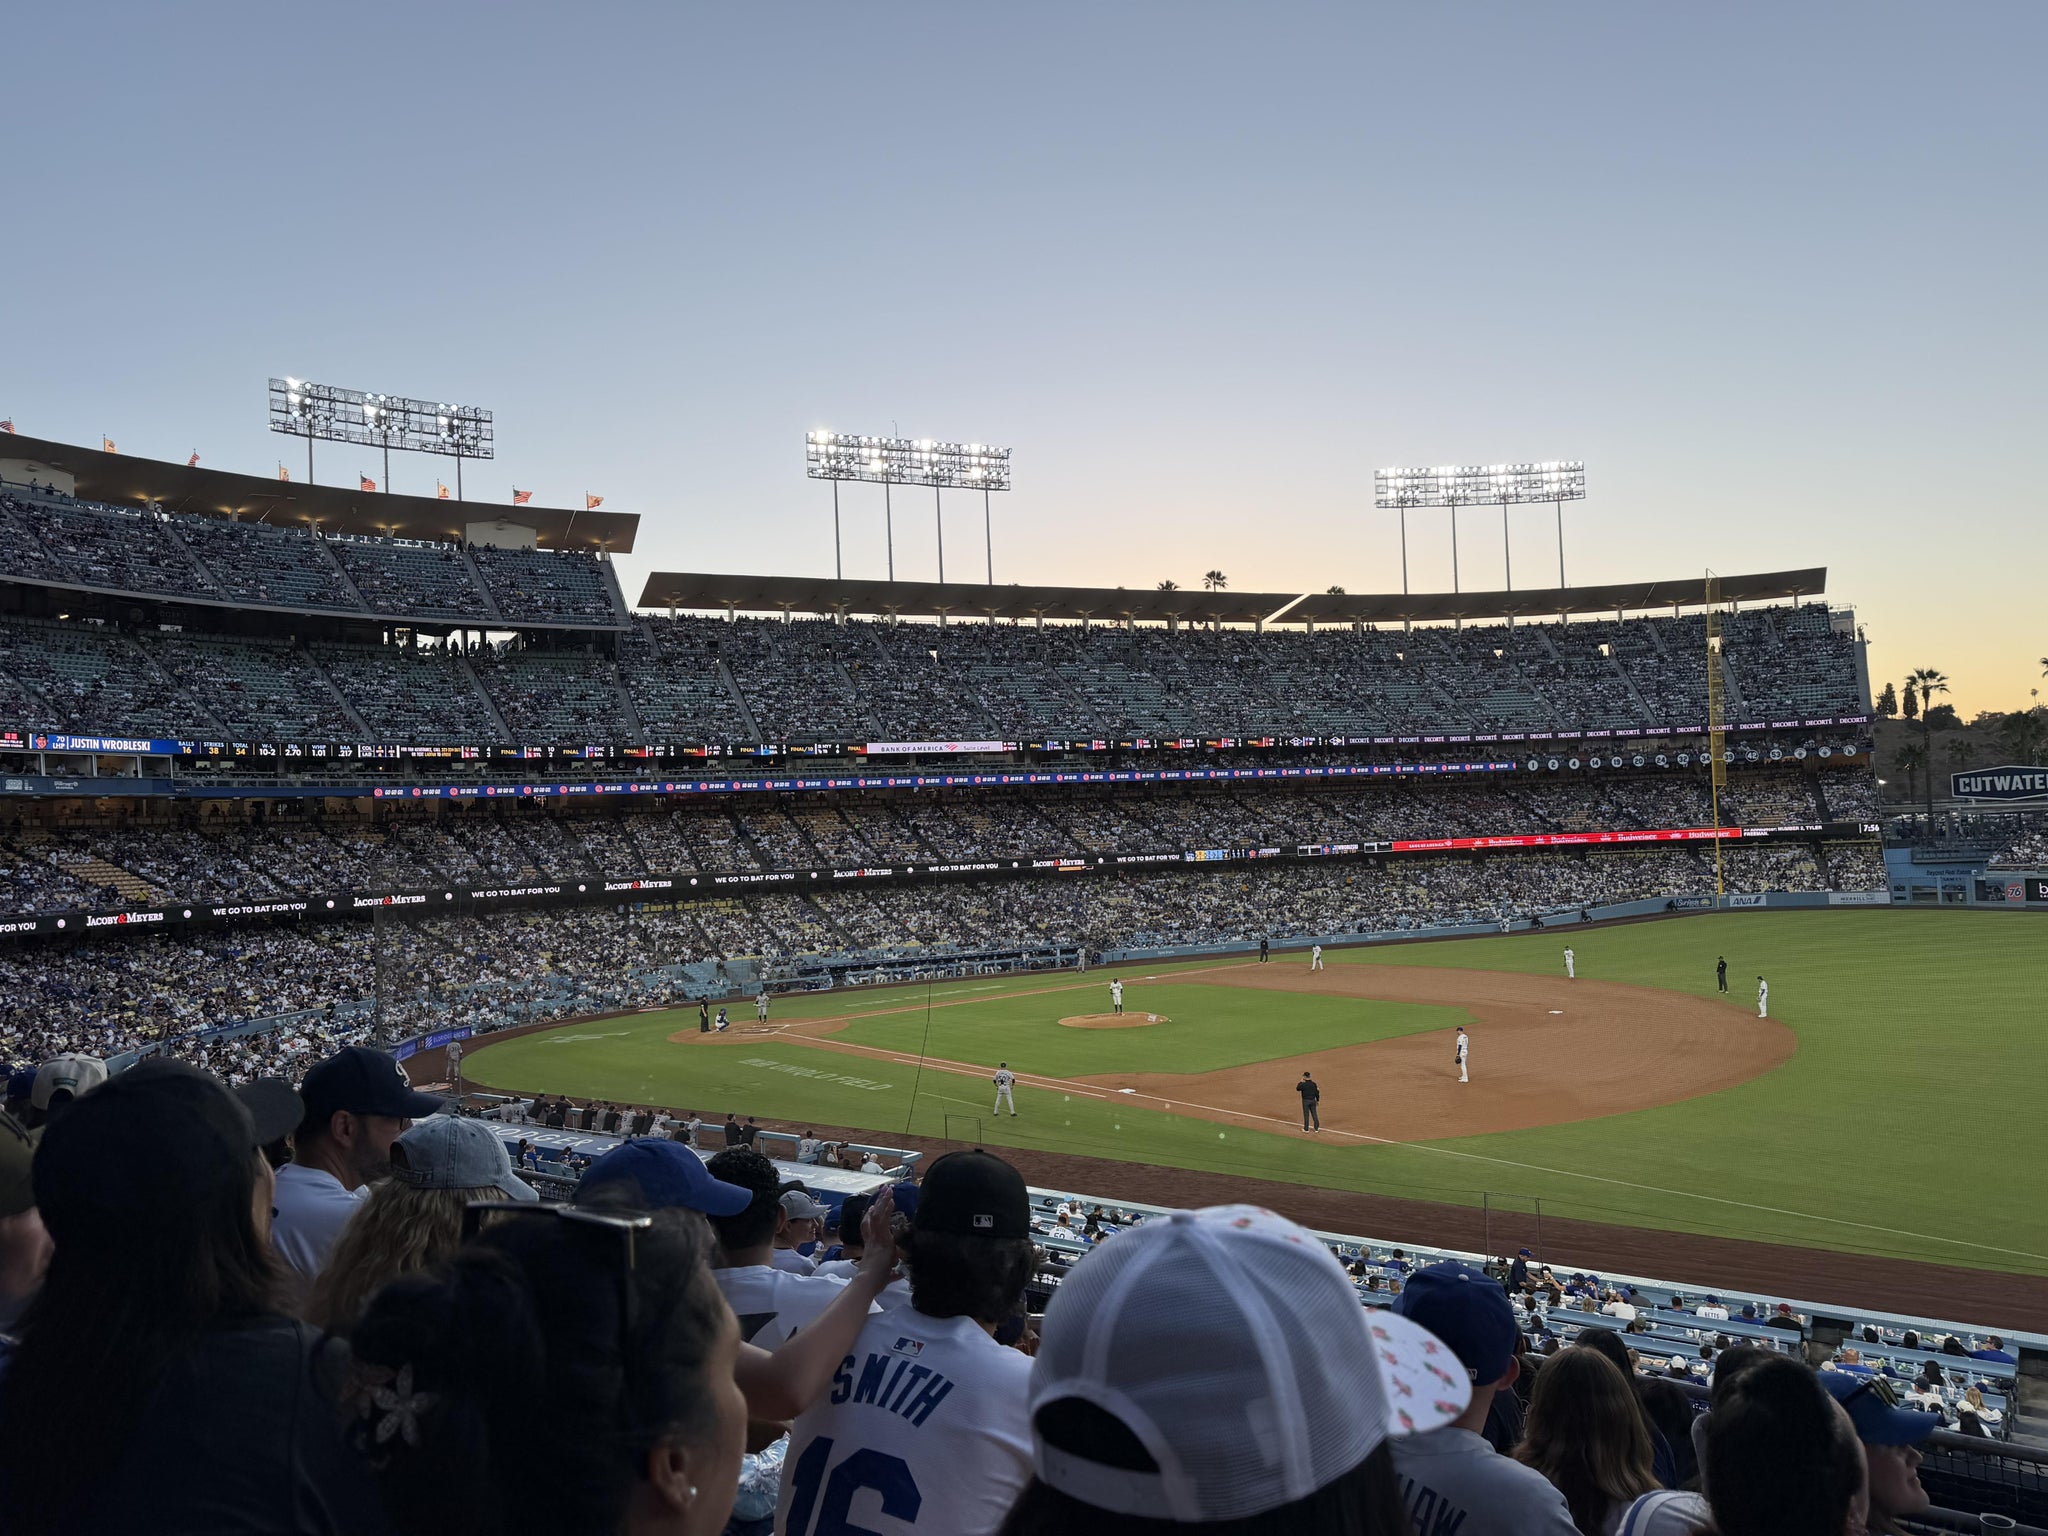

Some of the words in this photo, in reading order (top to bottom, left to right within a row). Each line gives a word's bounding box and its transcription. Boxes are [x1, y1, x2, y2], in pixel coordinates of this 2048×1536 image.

[70, 738, 99, 749] JUSTIN
[102, 739, 150, 751] WROBLESKI
[1959, 773, 2048, 793] CUTWATE
[1863, 824, 1880, 832] 7:56
[1618, 832, 1657, 841] Budweiser
[1689, 830, 1730, 839] Budweser
[511, 888, 526, 896] BAT
[527, 887, 543, 895] FOR
[2008, 886, 2022, 897] 76
[1733, 897, 1753, 905] ANA
[213, 907, 226, 916] WE
[228, 907, 240, 915] GO
[242, 906, 253, 914] TO
[254, 905, 271, 913] BAT
[272, 903, 289, 912] FOR
[290, 902, 307, 910] YOU
[86, 912, 163, 927] JACOBY&MEYERS
[0, 924, 16, 932] FOR
[17, 922, 36, 931] YOU
[827, 1076, 893, 1090] FIELD
[830, 1352, 955, 1428] SMITH
[785, 1435, 922, 1536] 16
